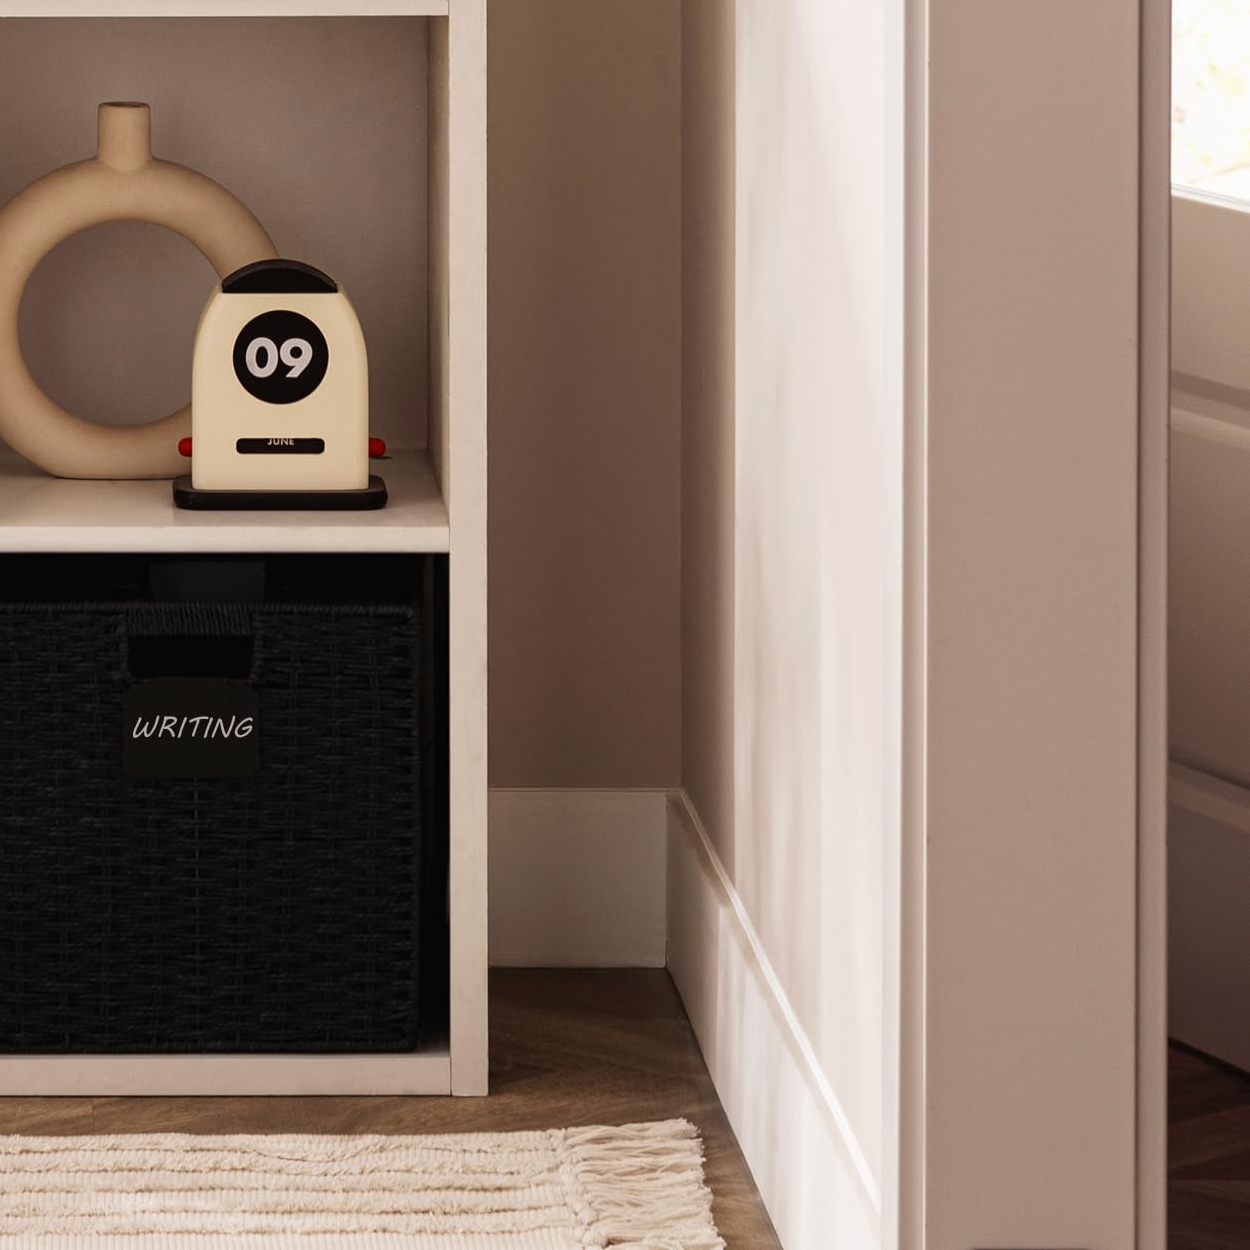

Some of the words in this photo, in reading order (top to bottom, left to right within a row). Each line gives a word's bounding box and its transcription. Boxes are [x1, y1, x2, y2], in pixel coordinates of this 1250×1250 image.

[245, 337, 313, 379] 09
[267, 438, 295, 446] JUNE
[132, 715, 254, 739] WRITING
